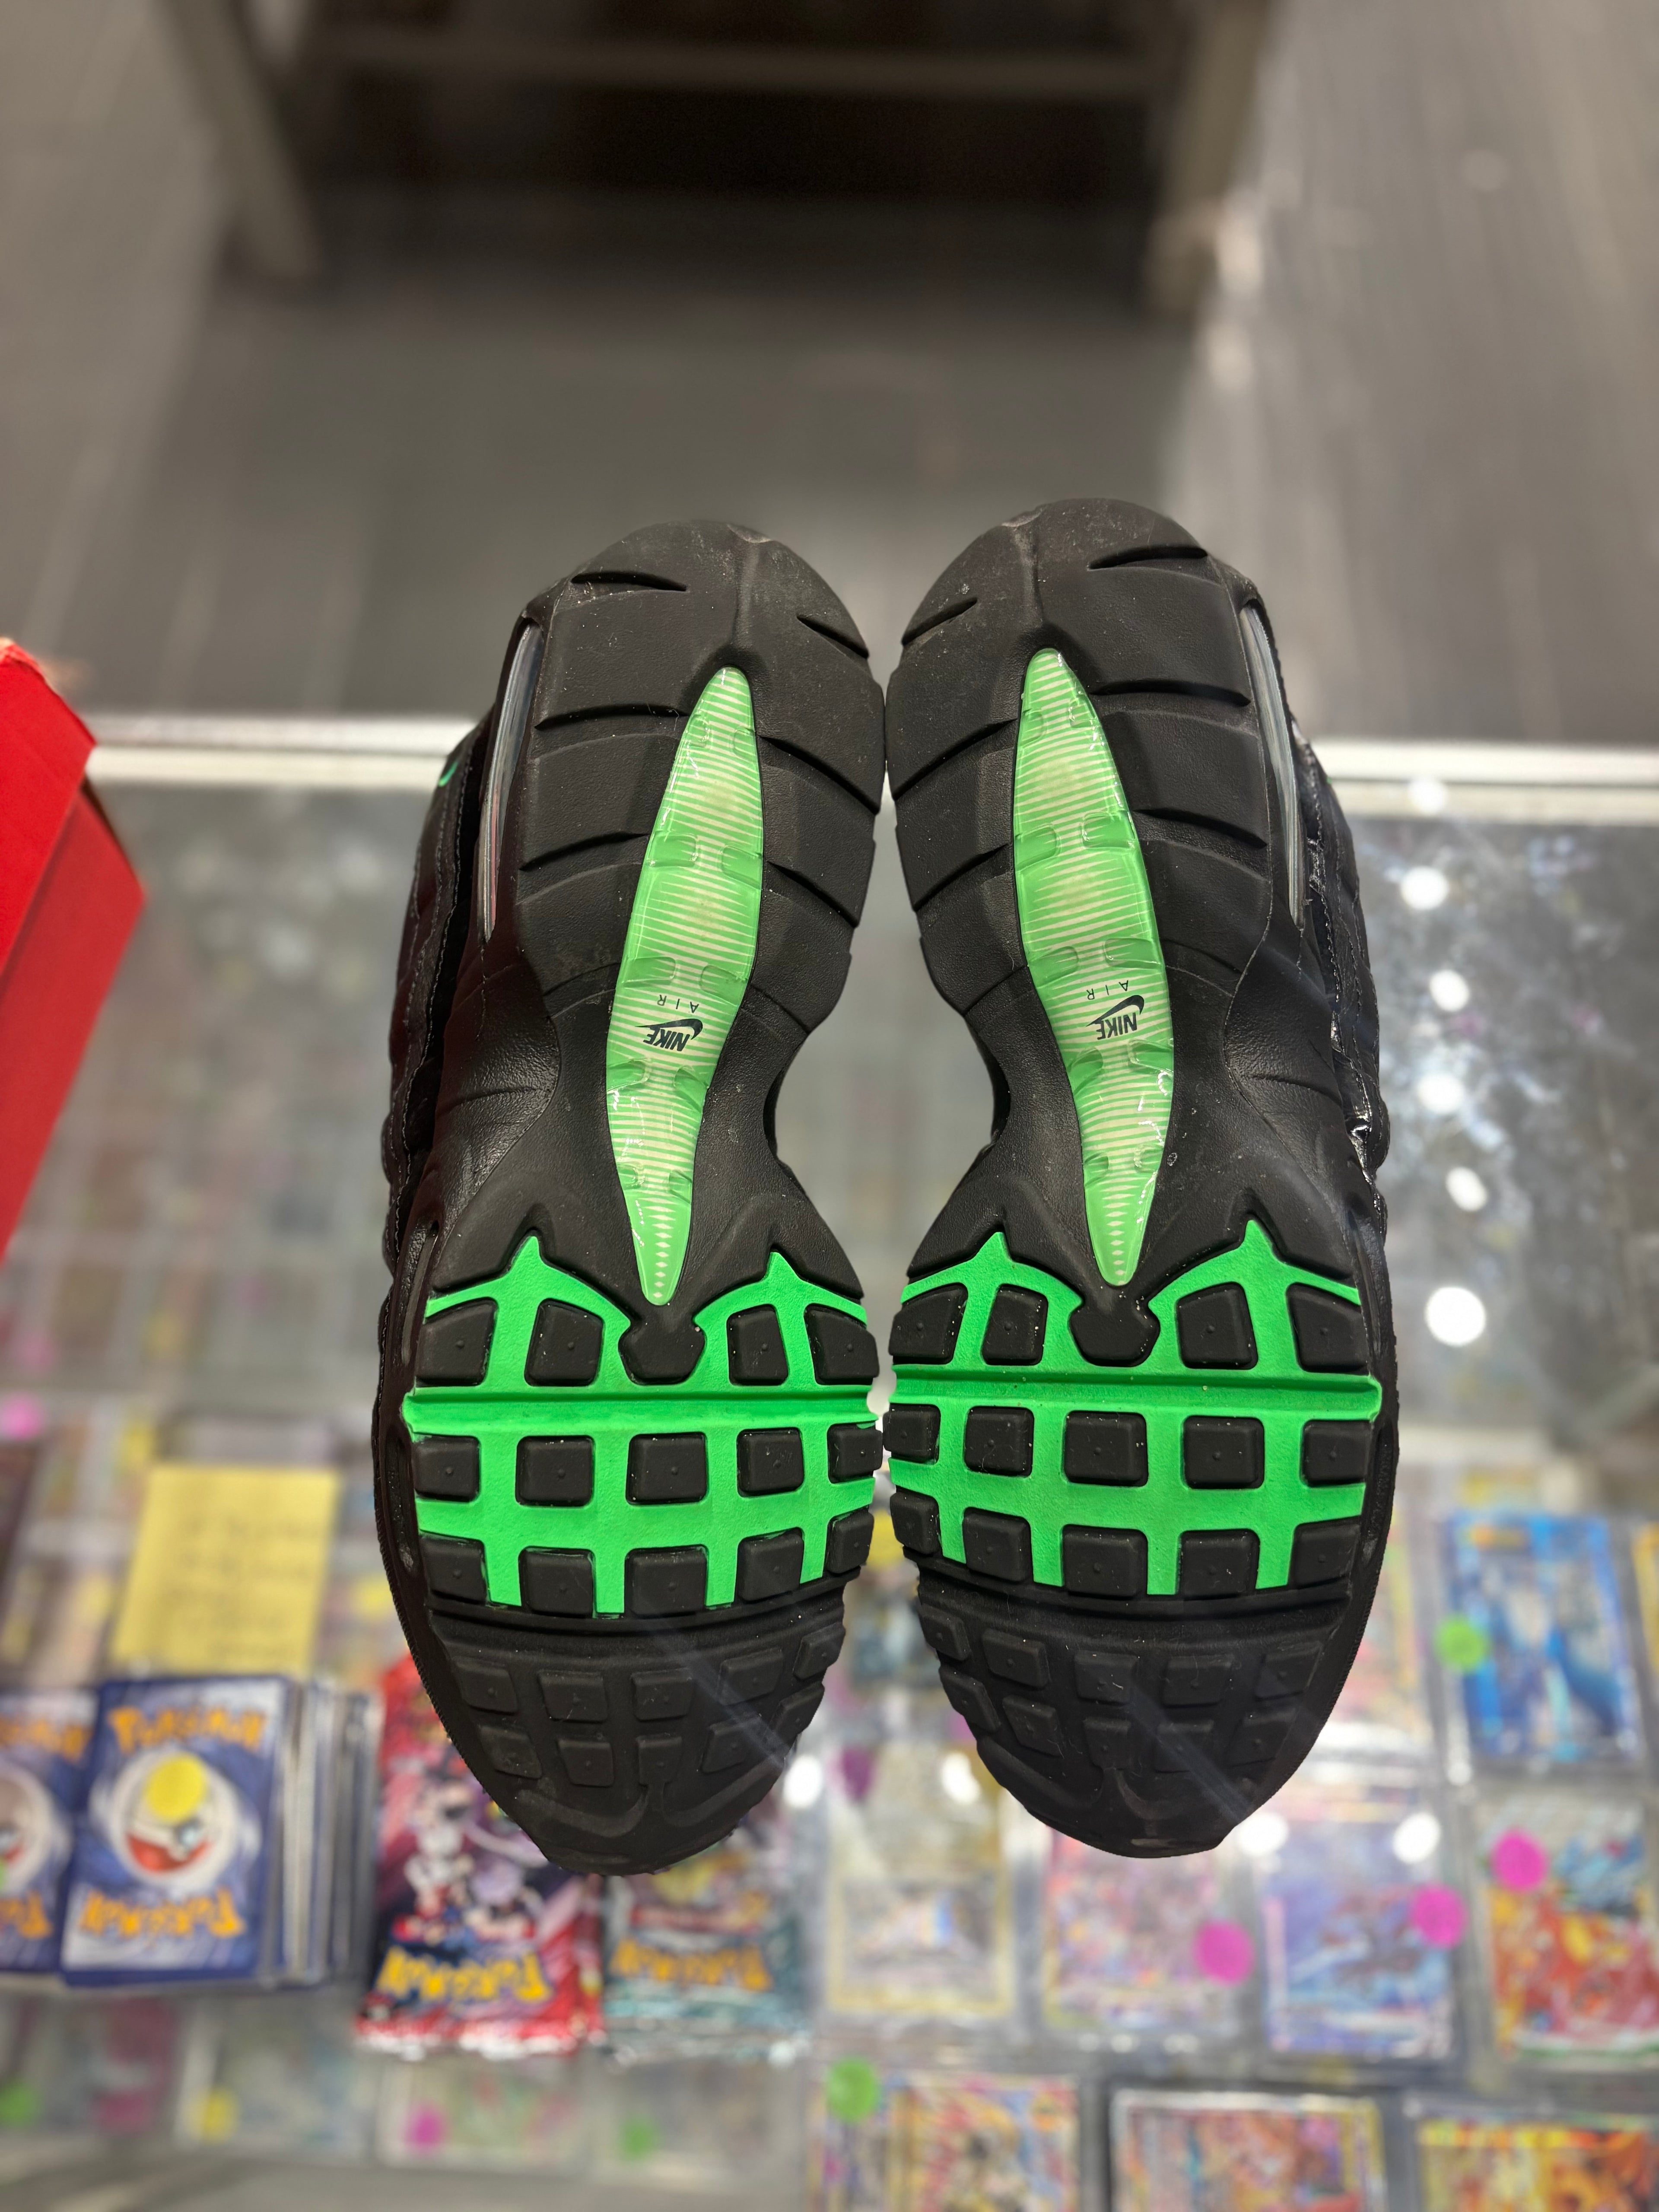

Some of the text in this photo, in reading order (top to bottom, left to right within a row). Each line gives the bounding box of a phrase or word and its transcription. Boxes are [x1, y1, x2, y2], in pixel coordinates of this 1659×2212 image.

[1086, 979, 1129, 1000] AIR
[657, 994, 699, 1014] AIR
[1096, 1012, 1138, 1040] NIKE
[643, 1027, 690, 1052] NIKE
